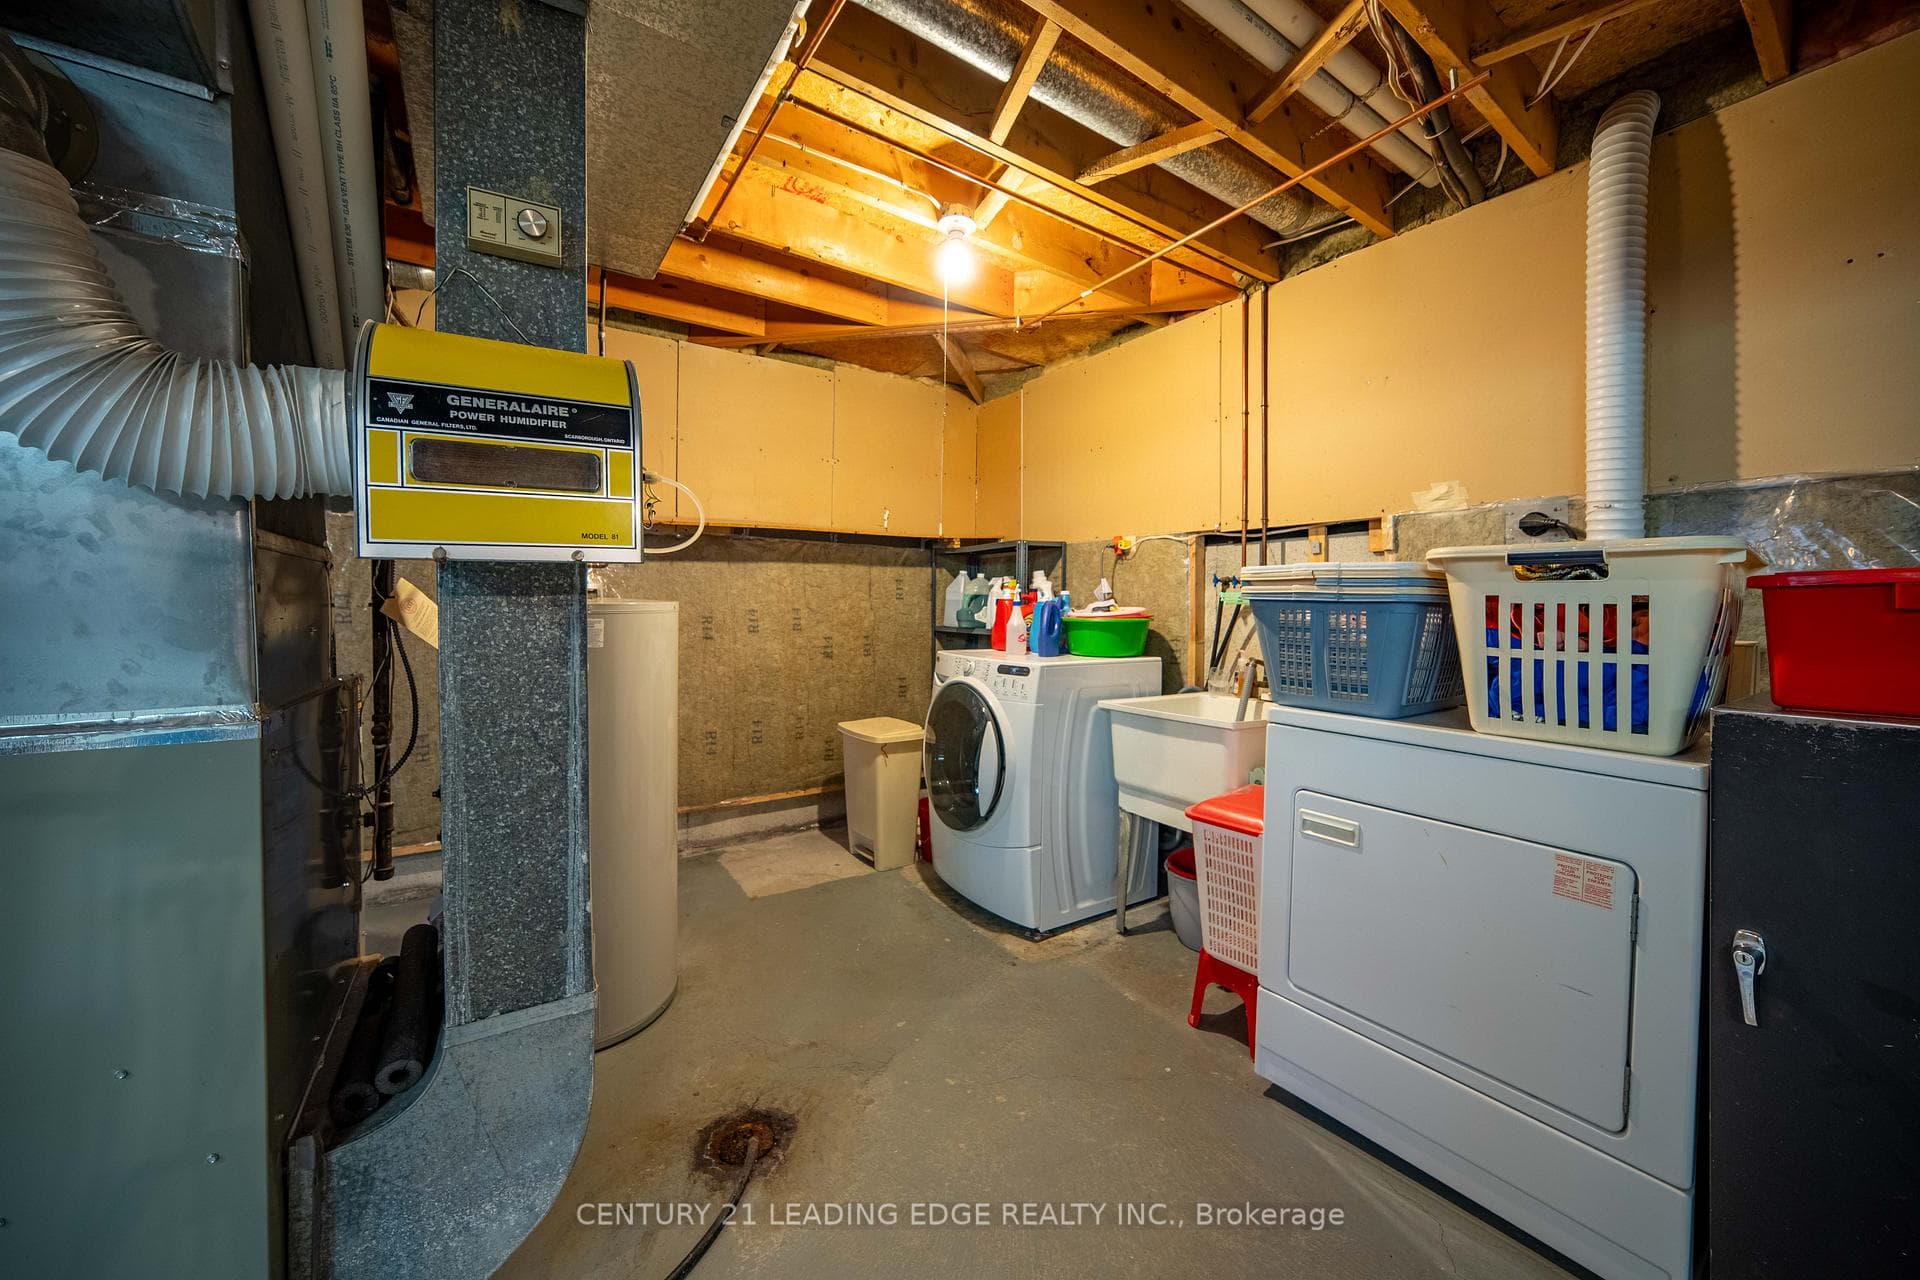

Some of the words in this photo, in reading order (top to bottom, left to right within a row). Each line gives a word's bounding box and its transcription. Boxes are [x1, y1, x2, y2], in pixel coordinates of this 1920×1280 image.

[333, 110, 342, 138] CLASS
[340, 176, 348, 197] VENT
[342, 199, 350, 215] GAS
[376, 416, 409, 425] CANADIAN
[449, 410, 495, 422] POWER
[500, 415, 567, 429] HUMIDIFIER
